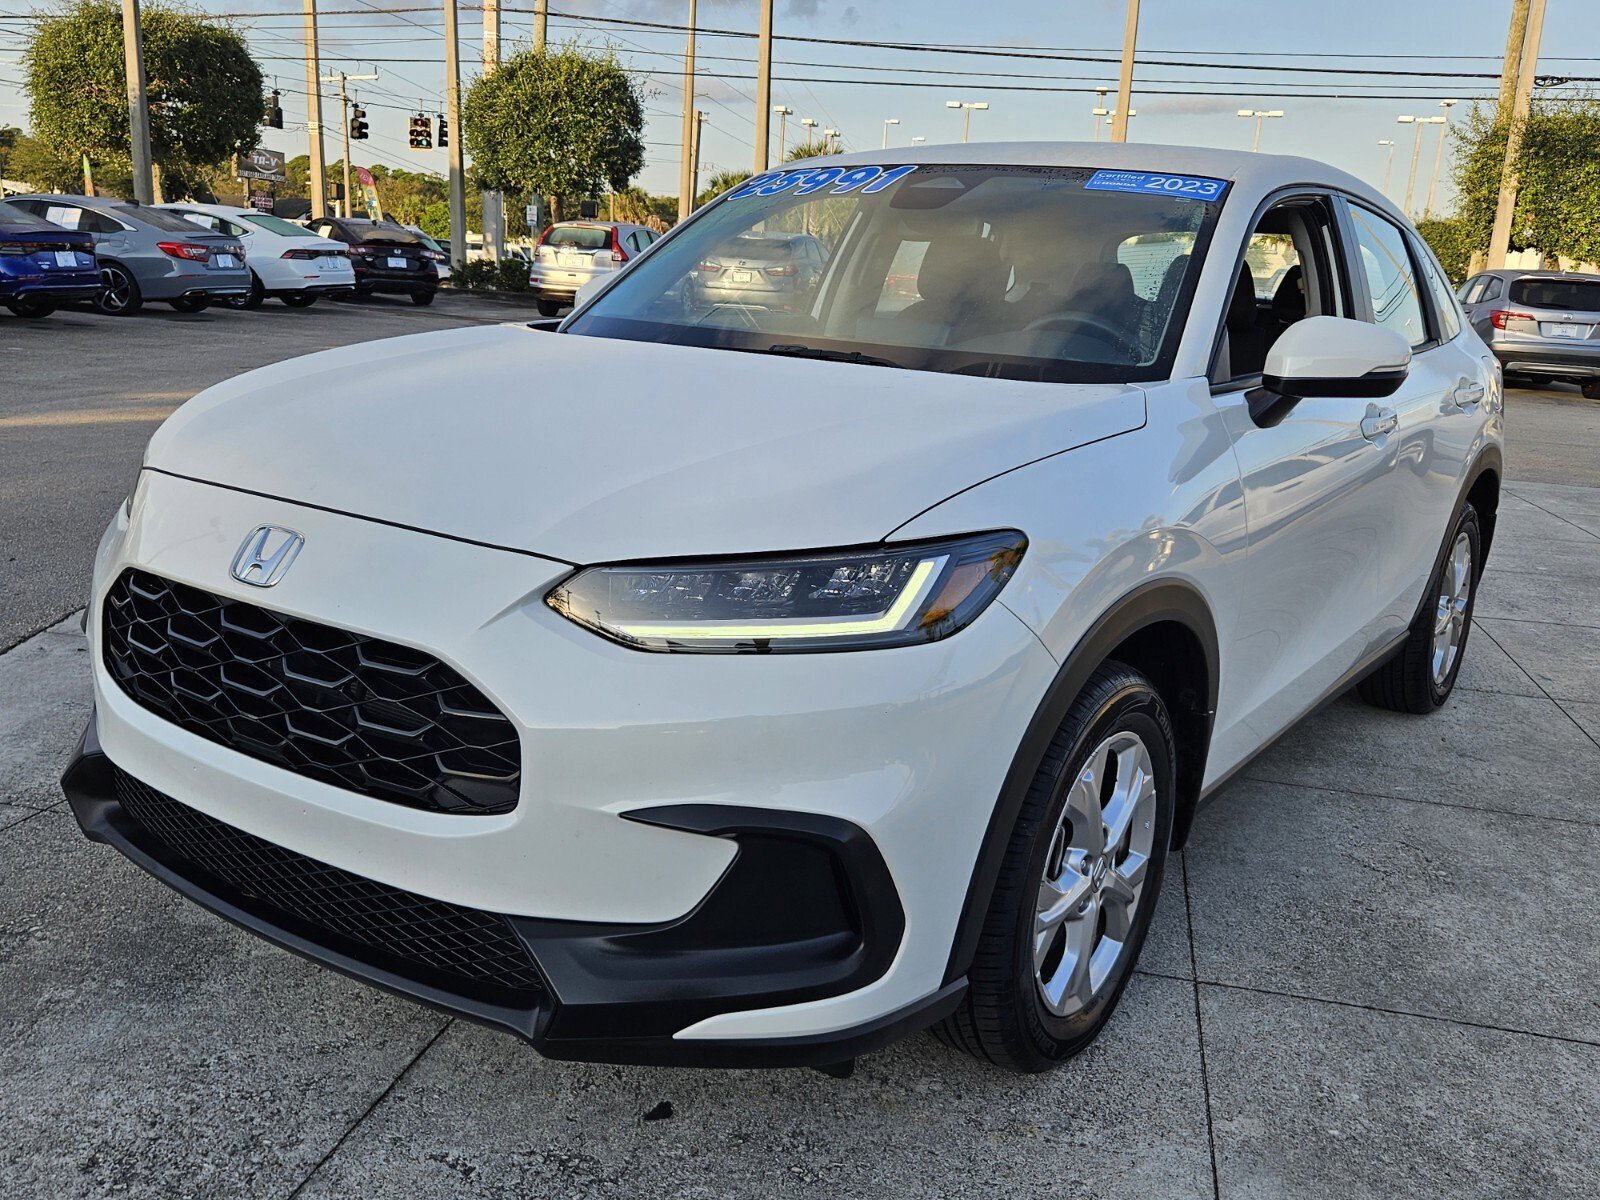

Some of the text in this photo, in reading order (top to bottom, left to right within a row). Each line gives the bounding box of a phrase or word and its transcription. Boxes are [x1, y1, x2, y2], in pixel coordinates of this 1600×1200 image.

[727, 164, 919, 201] 25991
[1098, 172, 1146, 180] Certified
[1144, 176, 1219, 195] 2023
